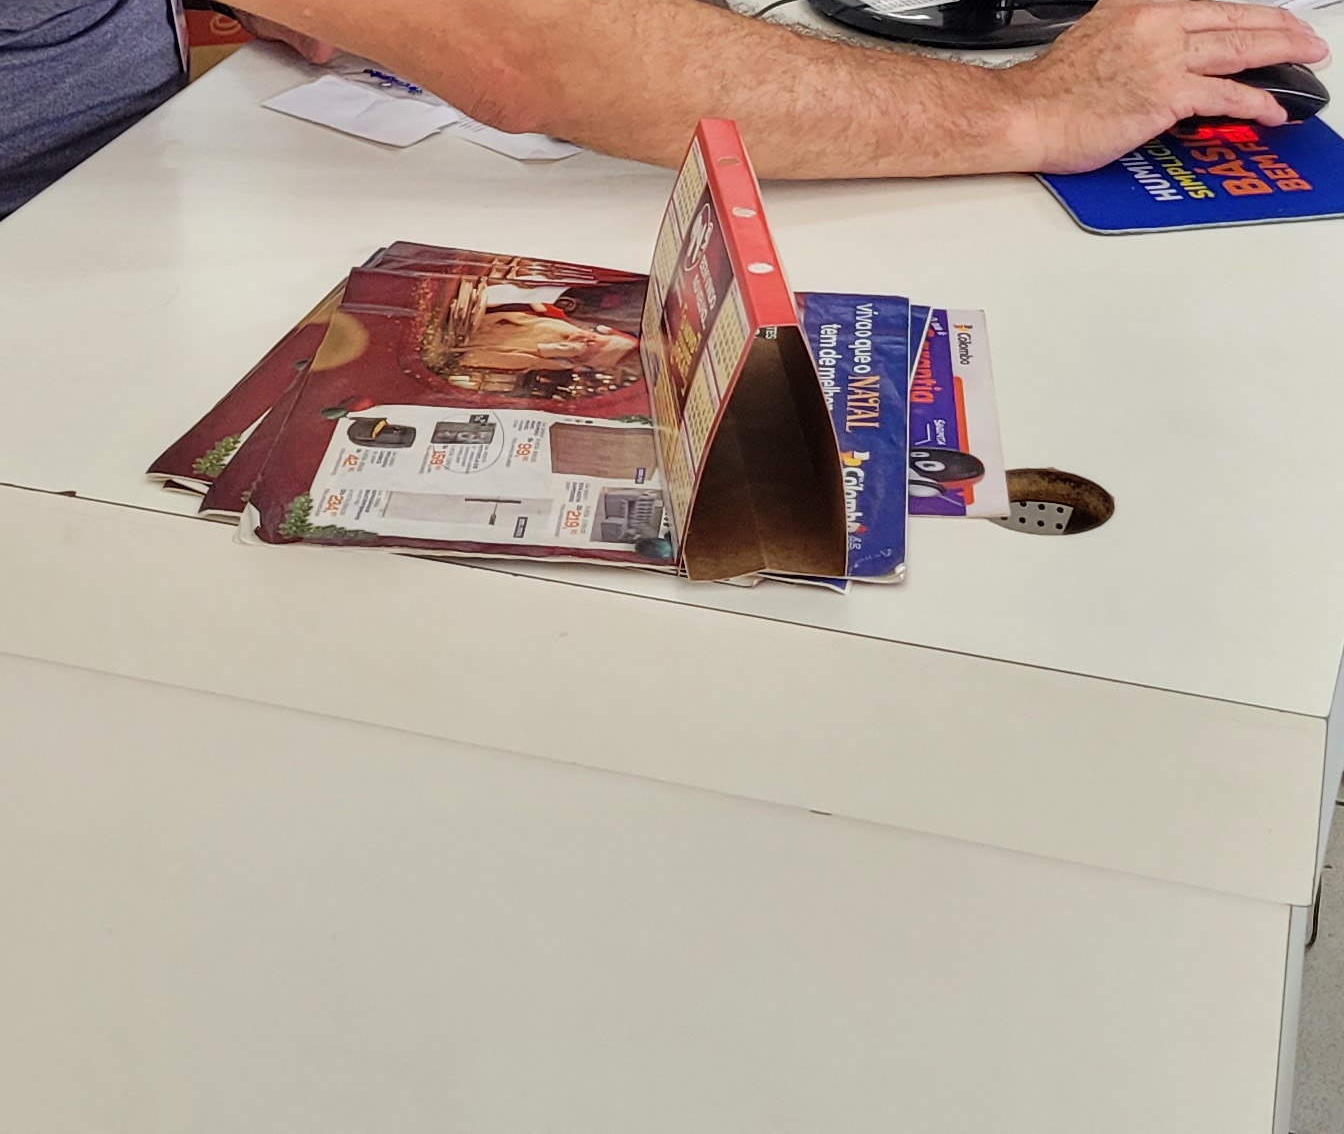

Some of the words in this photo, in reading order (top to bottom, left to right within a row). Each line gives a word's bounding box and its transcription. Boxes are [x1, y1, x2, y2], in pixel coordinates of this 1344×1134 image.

[1250, 154, 1312, 192] BEM
[855, 303, 873, 330] viva
[820, 323, 841, 346] tem
[957, 332, 971, 365] Colombo
[848, 339, 872, 363] que
[846, 375, 880, 434] NATAL
